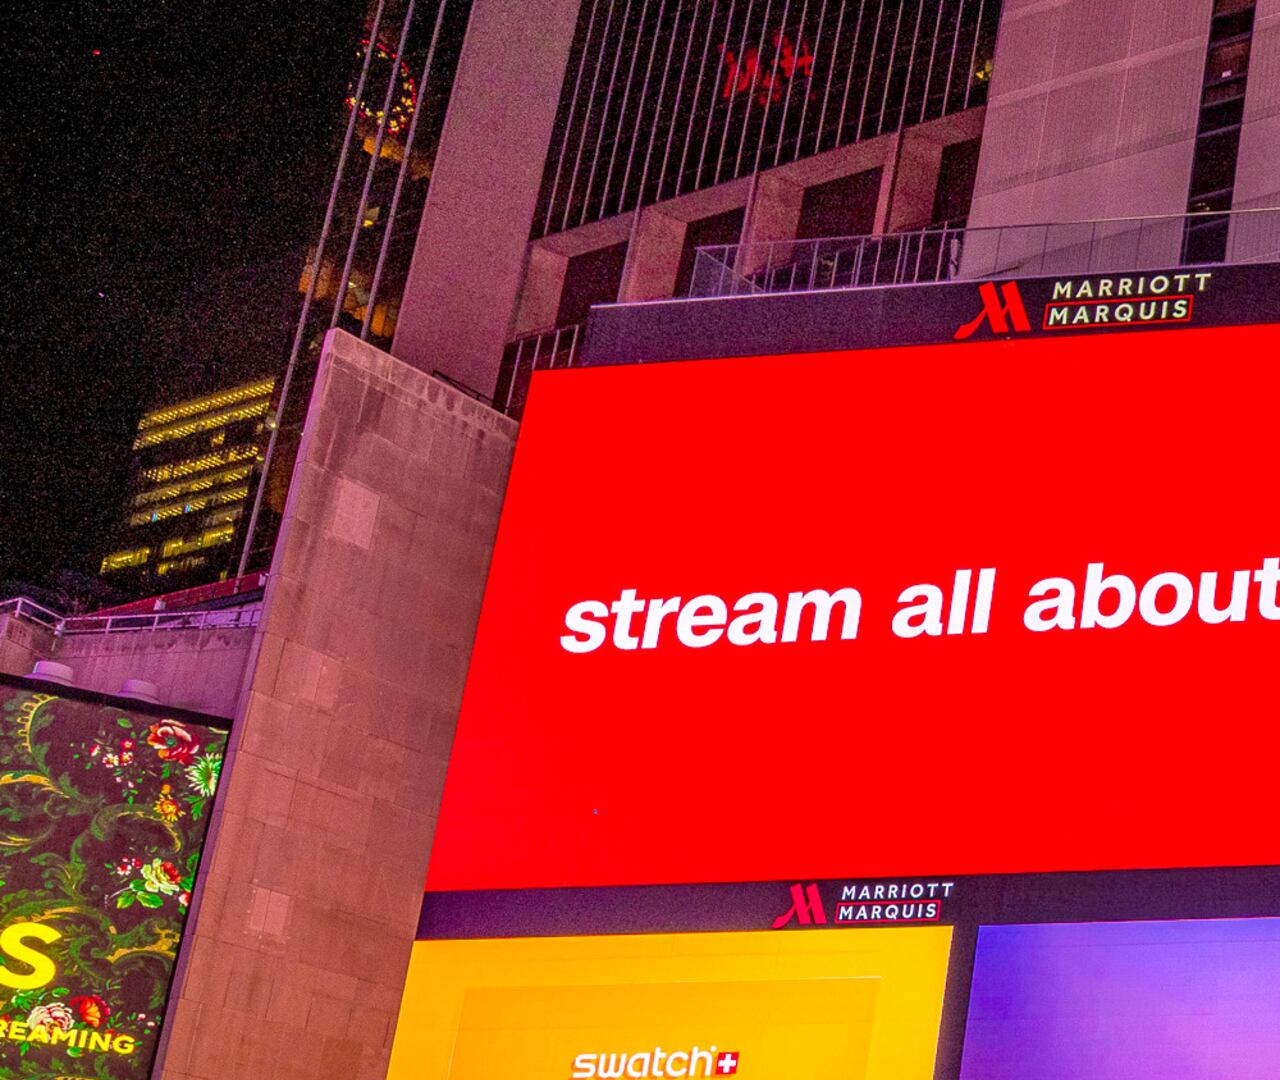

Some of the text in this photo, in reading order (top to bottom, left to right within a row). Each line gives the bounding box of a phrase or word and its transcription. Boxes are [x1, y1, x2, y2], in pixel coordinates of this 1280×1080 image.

[1052, 272, 1212, 301] MARRIOTT
[1048, 298, 1189, 325] MARQUIS
[561, 588, 861, 652] stream
[892, 568, 996, 637] all
[841, 882, 954, 899] MARRIOTT
[839, 903, 937, 920] MARQUIS
[573, 1046, 714, 1079] swatch
